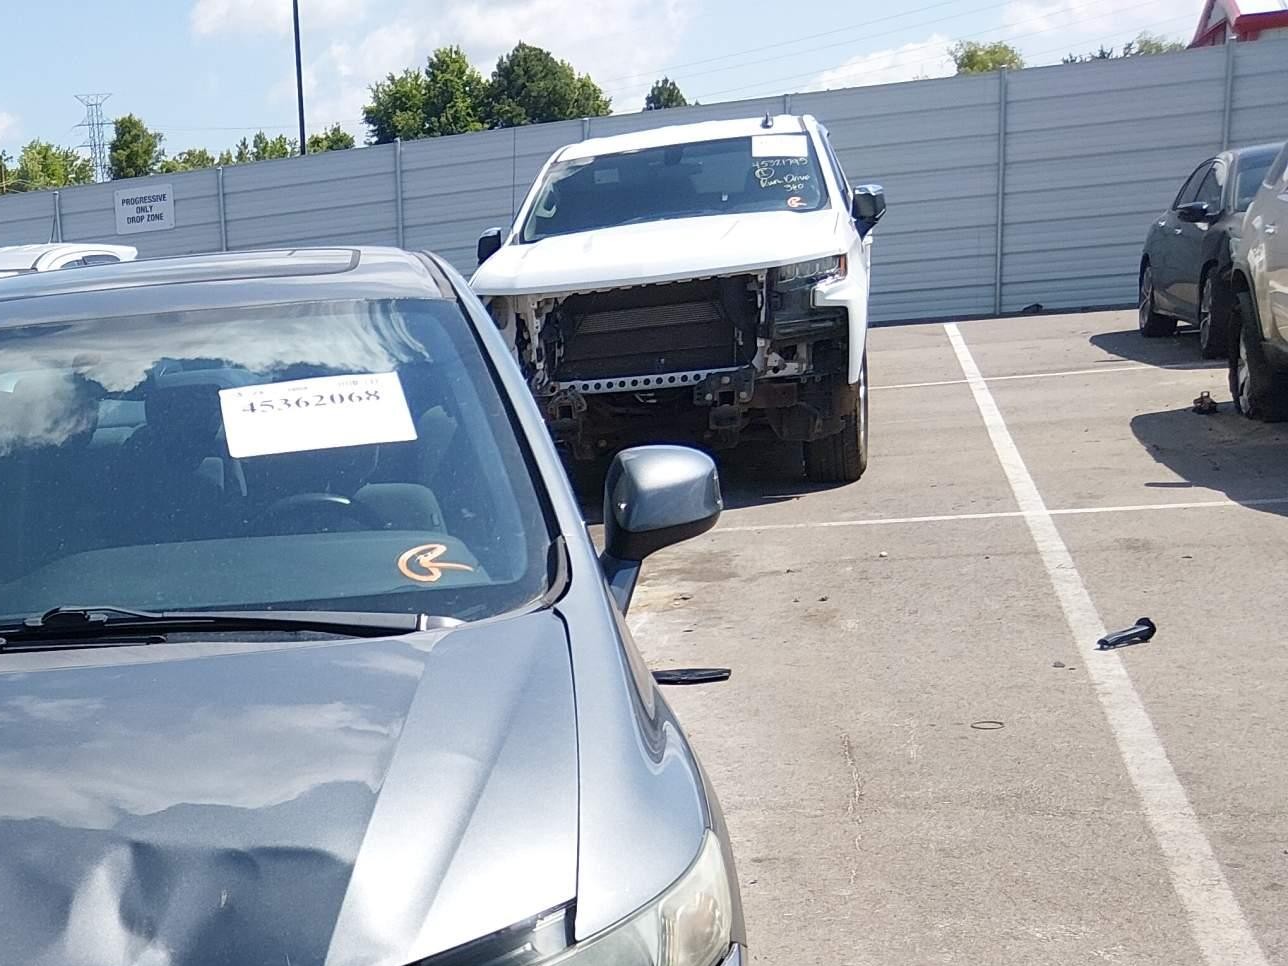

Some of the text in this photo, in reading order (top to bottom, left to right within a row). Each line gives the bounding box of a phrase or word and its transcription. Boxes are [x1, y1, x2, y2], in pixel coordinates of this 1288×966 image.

[121, 193, 167, 206] PROGRESSIVE
[135, 205, 153, 214] ONLY
[126, 213, 164, 224] DROP ZONE
[242, 390, 380, 413] 45362068
